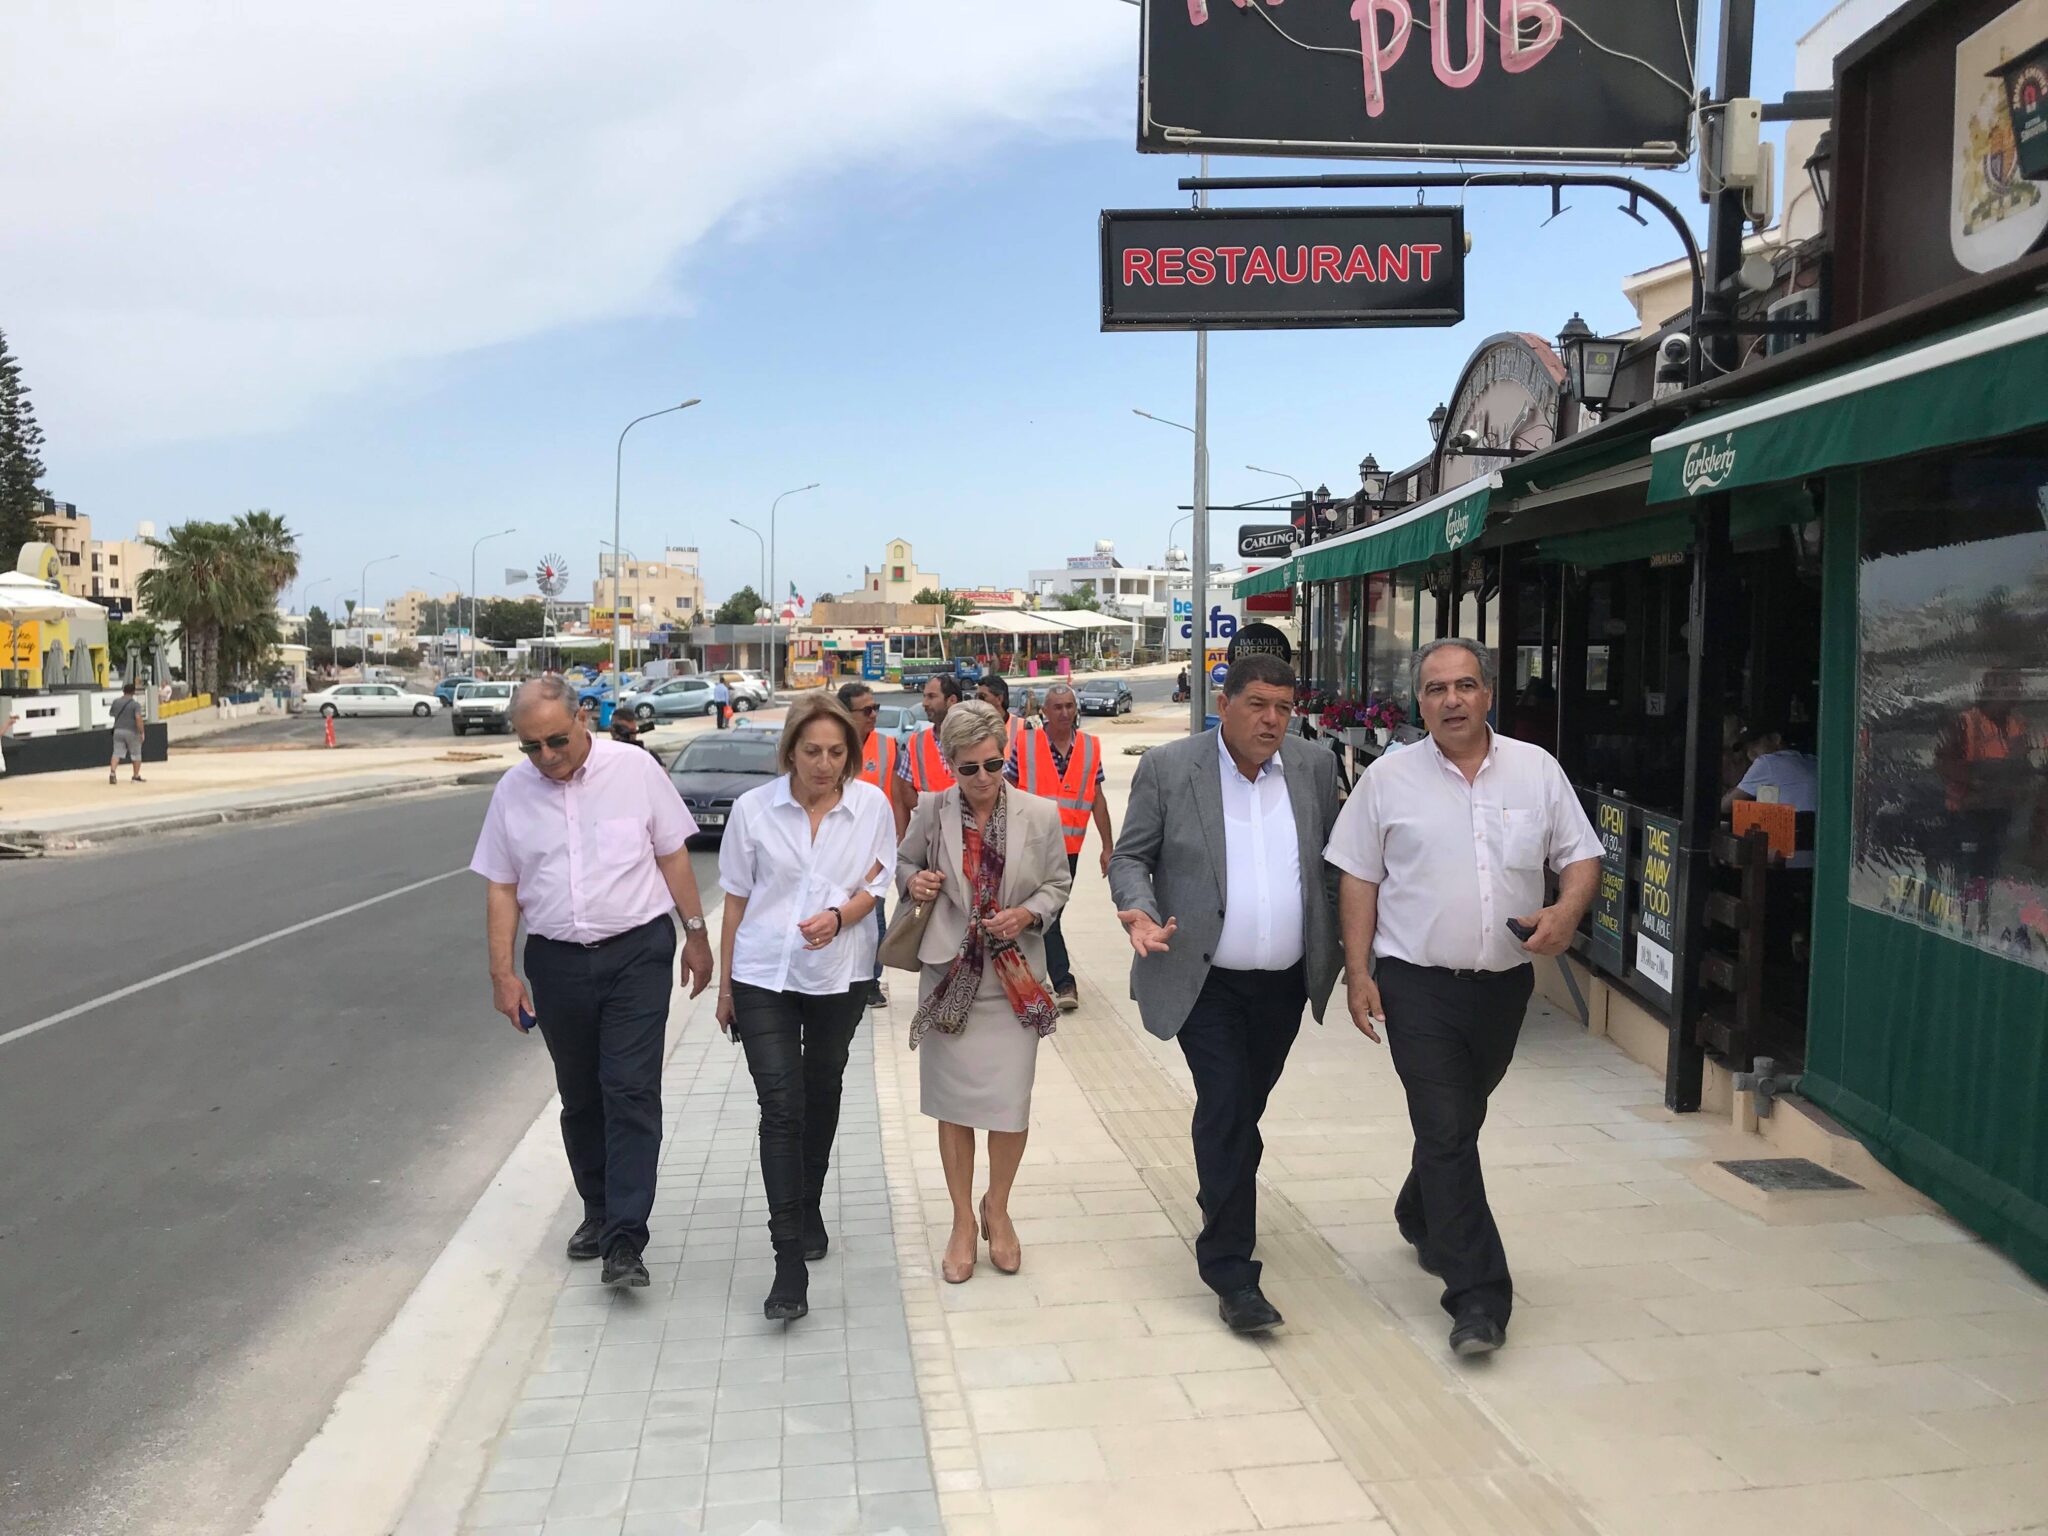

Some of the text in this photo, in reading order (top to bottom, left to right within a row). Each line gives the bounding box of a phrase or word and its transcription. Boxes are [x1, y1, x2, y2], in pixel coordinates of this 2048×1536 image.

[1350, 0, 1562, 117] PUB
[1123, 243, 1442, 287] RESTAURANT
[1682, 441, 1736, 493] Carlsberg
[1241, 531, 1294, 552] CARLING
[8, 629, 31, 641] Tke
[1181, 605, 1238, 639] afa
[1234, 645, 1286, 661] BREEZER
[1240, 637, 1279, 647] BACARDI
[1600, 804, 1623, 835] OPEN
[1647, 825, 1670, 857] TAKE
[1644, 855, 1671, 887] AWAY
[1601, 884, 1617, 903] LUNCH
[1643, 884, 1670, 916] FOOD
[1598, 911, 1619, 933] DINNER
[1642, 911, 1671, 940] AVAILABLE
